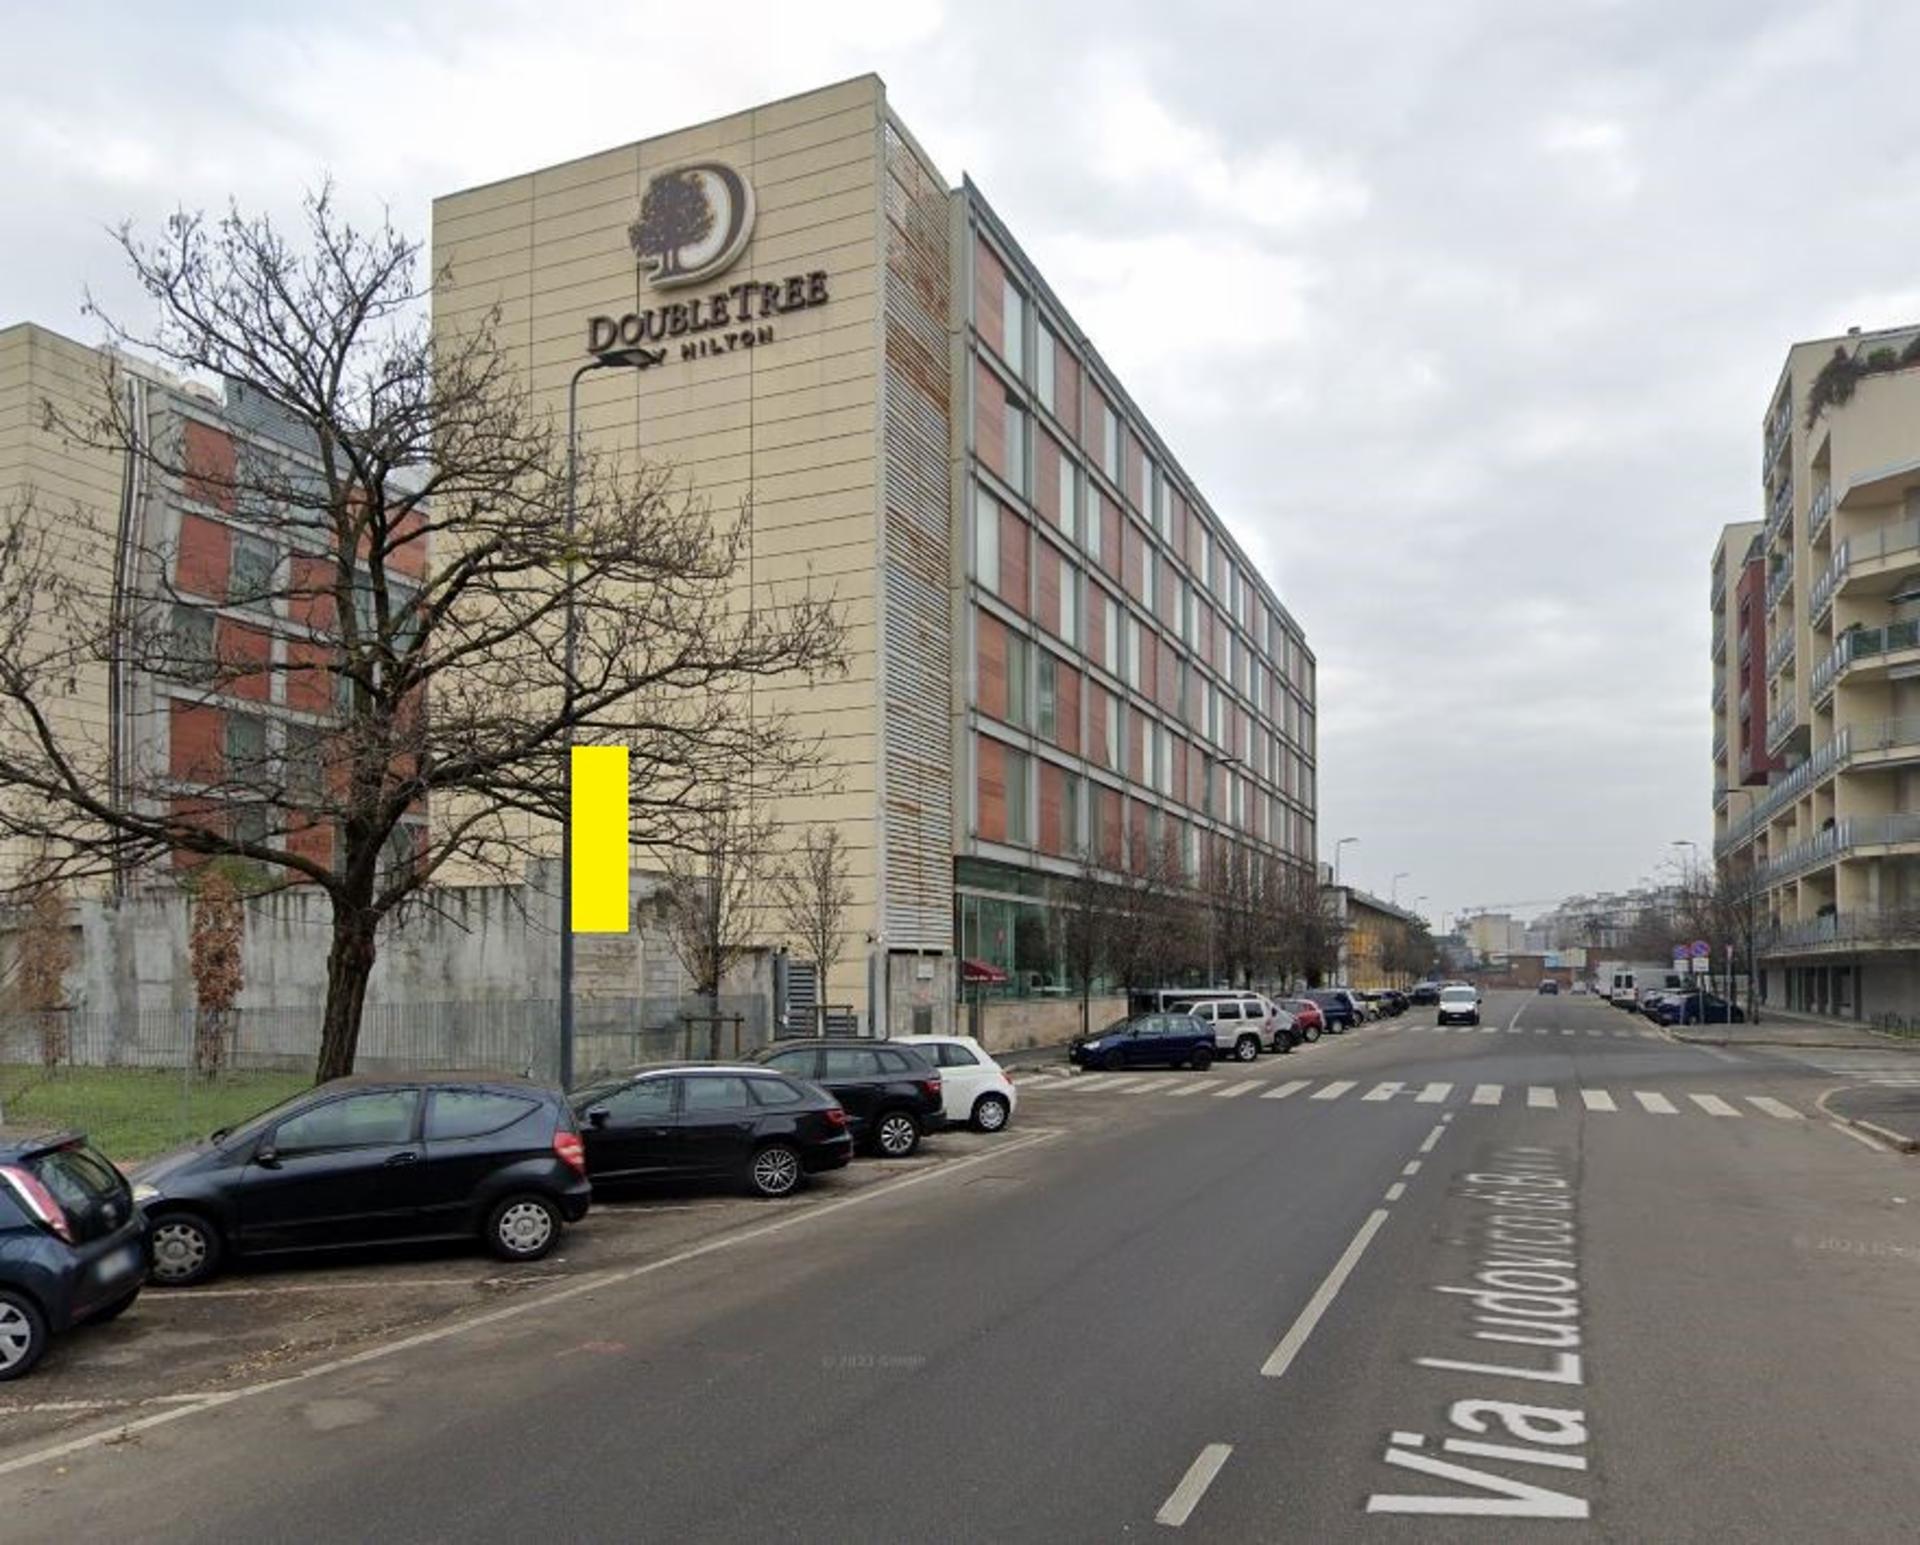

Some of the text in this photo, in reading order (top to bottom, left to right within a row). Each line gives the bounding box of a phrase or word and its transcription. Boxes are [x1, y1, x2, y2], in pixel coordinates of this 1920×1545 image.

[587, 269, 829, 355] DOUBLETREE
[681, 326, 774, 361] HILTON
[1411, 1214, 1584, 1385] Ludovico
[1366, 1398, 1590, 1519] Via
